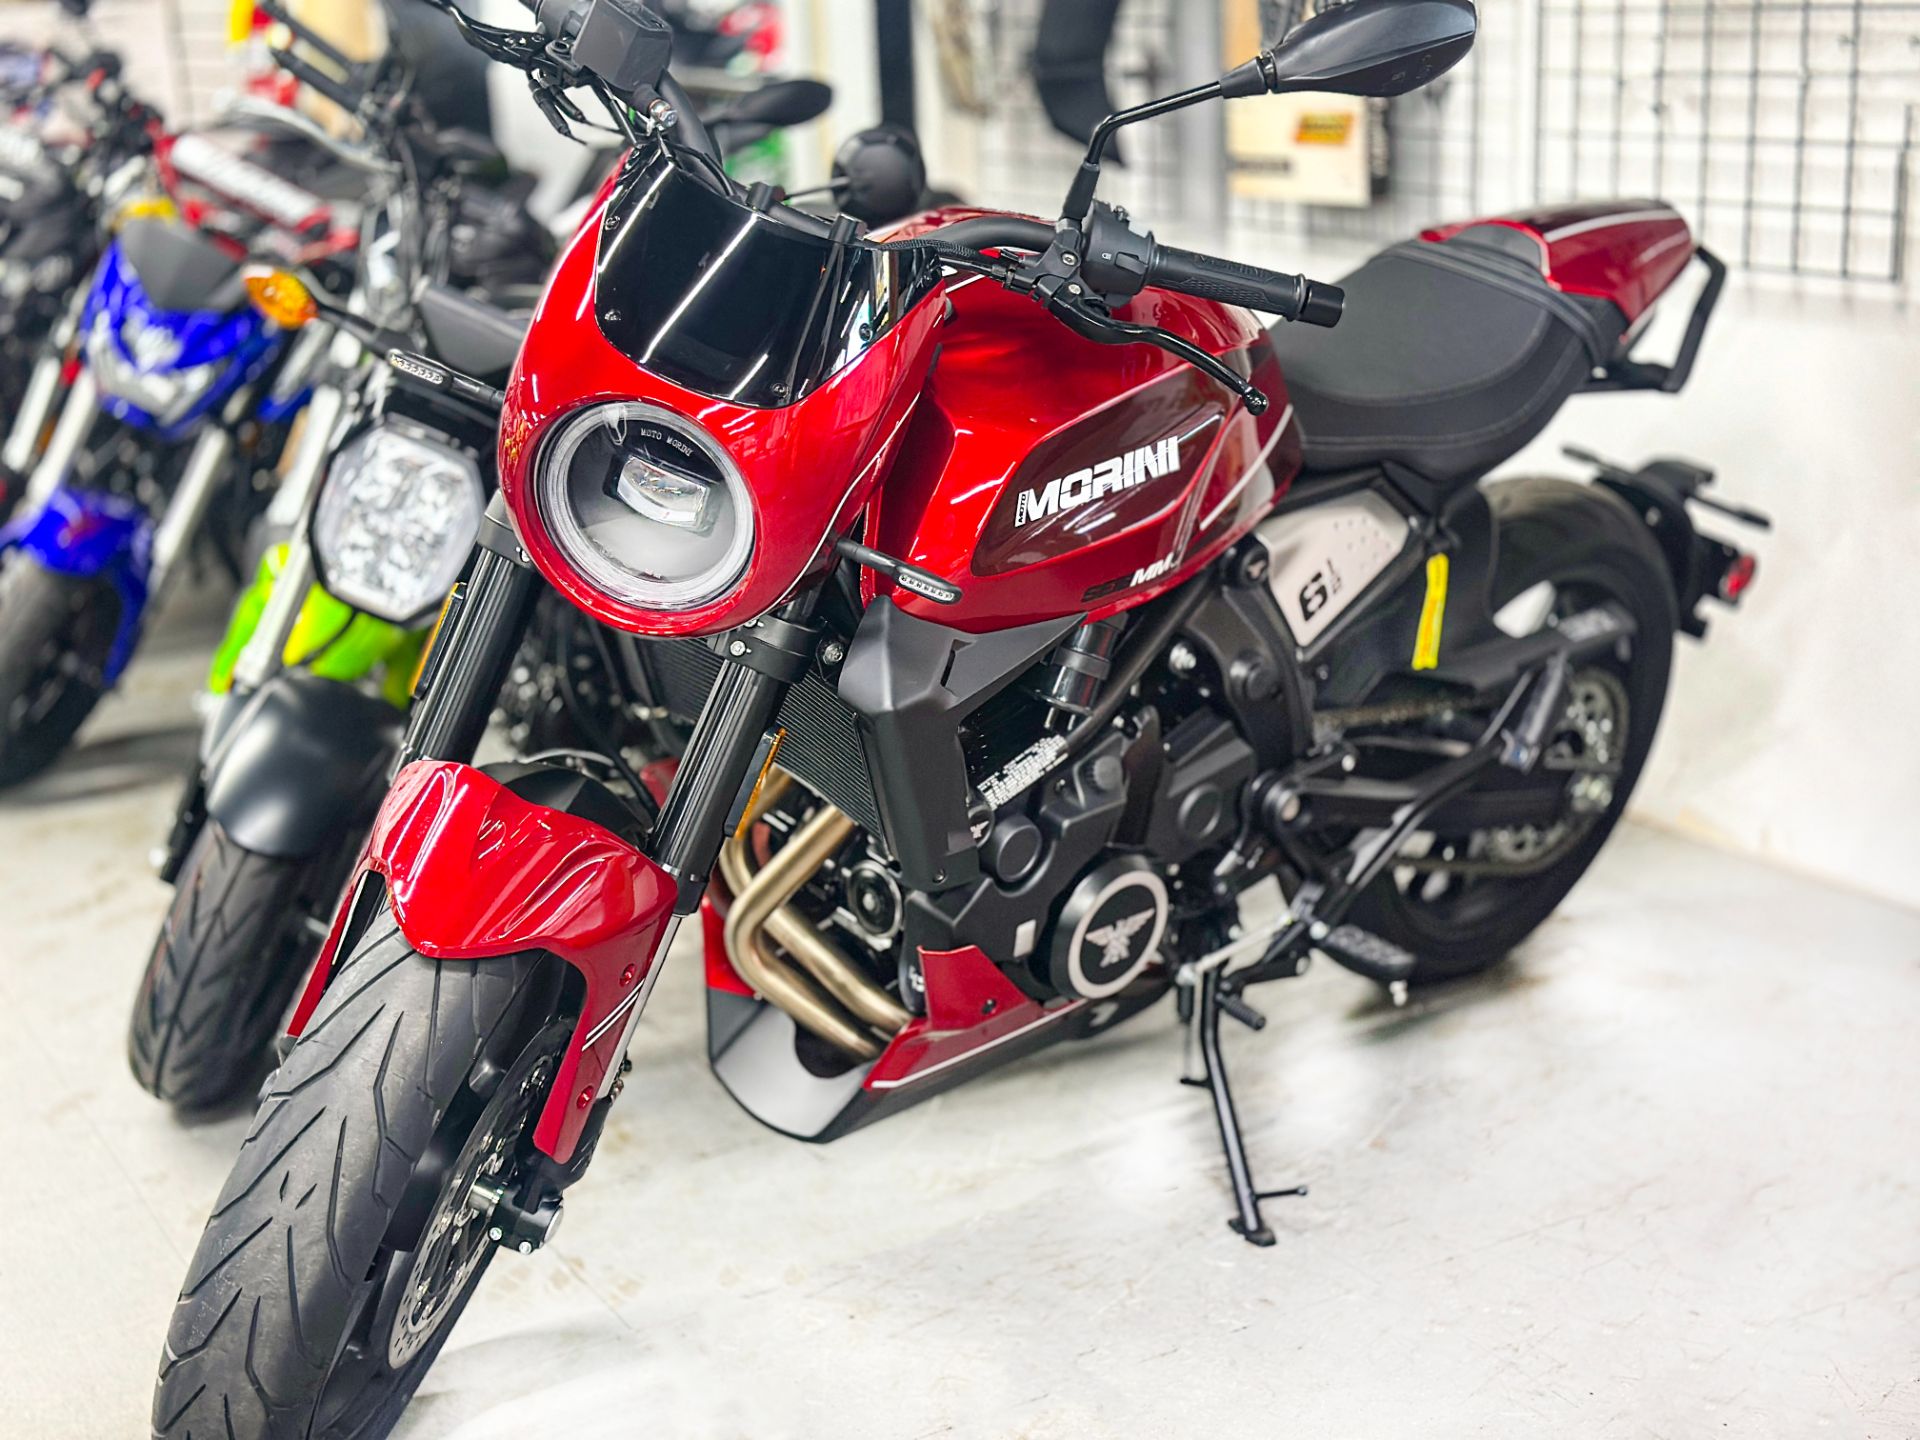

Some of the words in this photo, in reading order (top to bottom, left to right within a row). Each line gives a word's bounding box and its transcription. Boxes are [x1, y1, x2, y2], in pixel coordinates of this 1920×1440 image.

[640, 427, 662, 440] MOTO
[666, 435, 694, 457] MORINI
[1027, 435, 1181, 522] MORINI
[1018, 493, 1026, 523] MOTO
